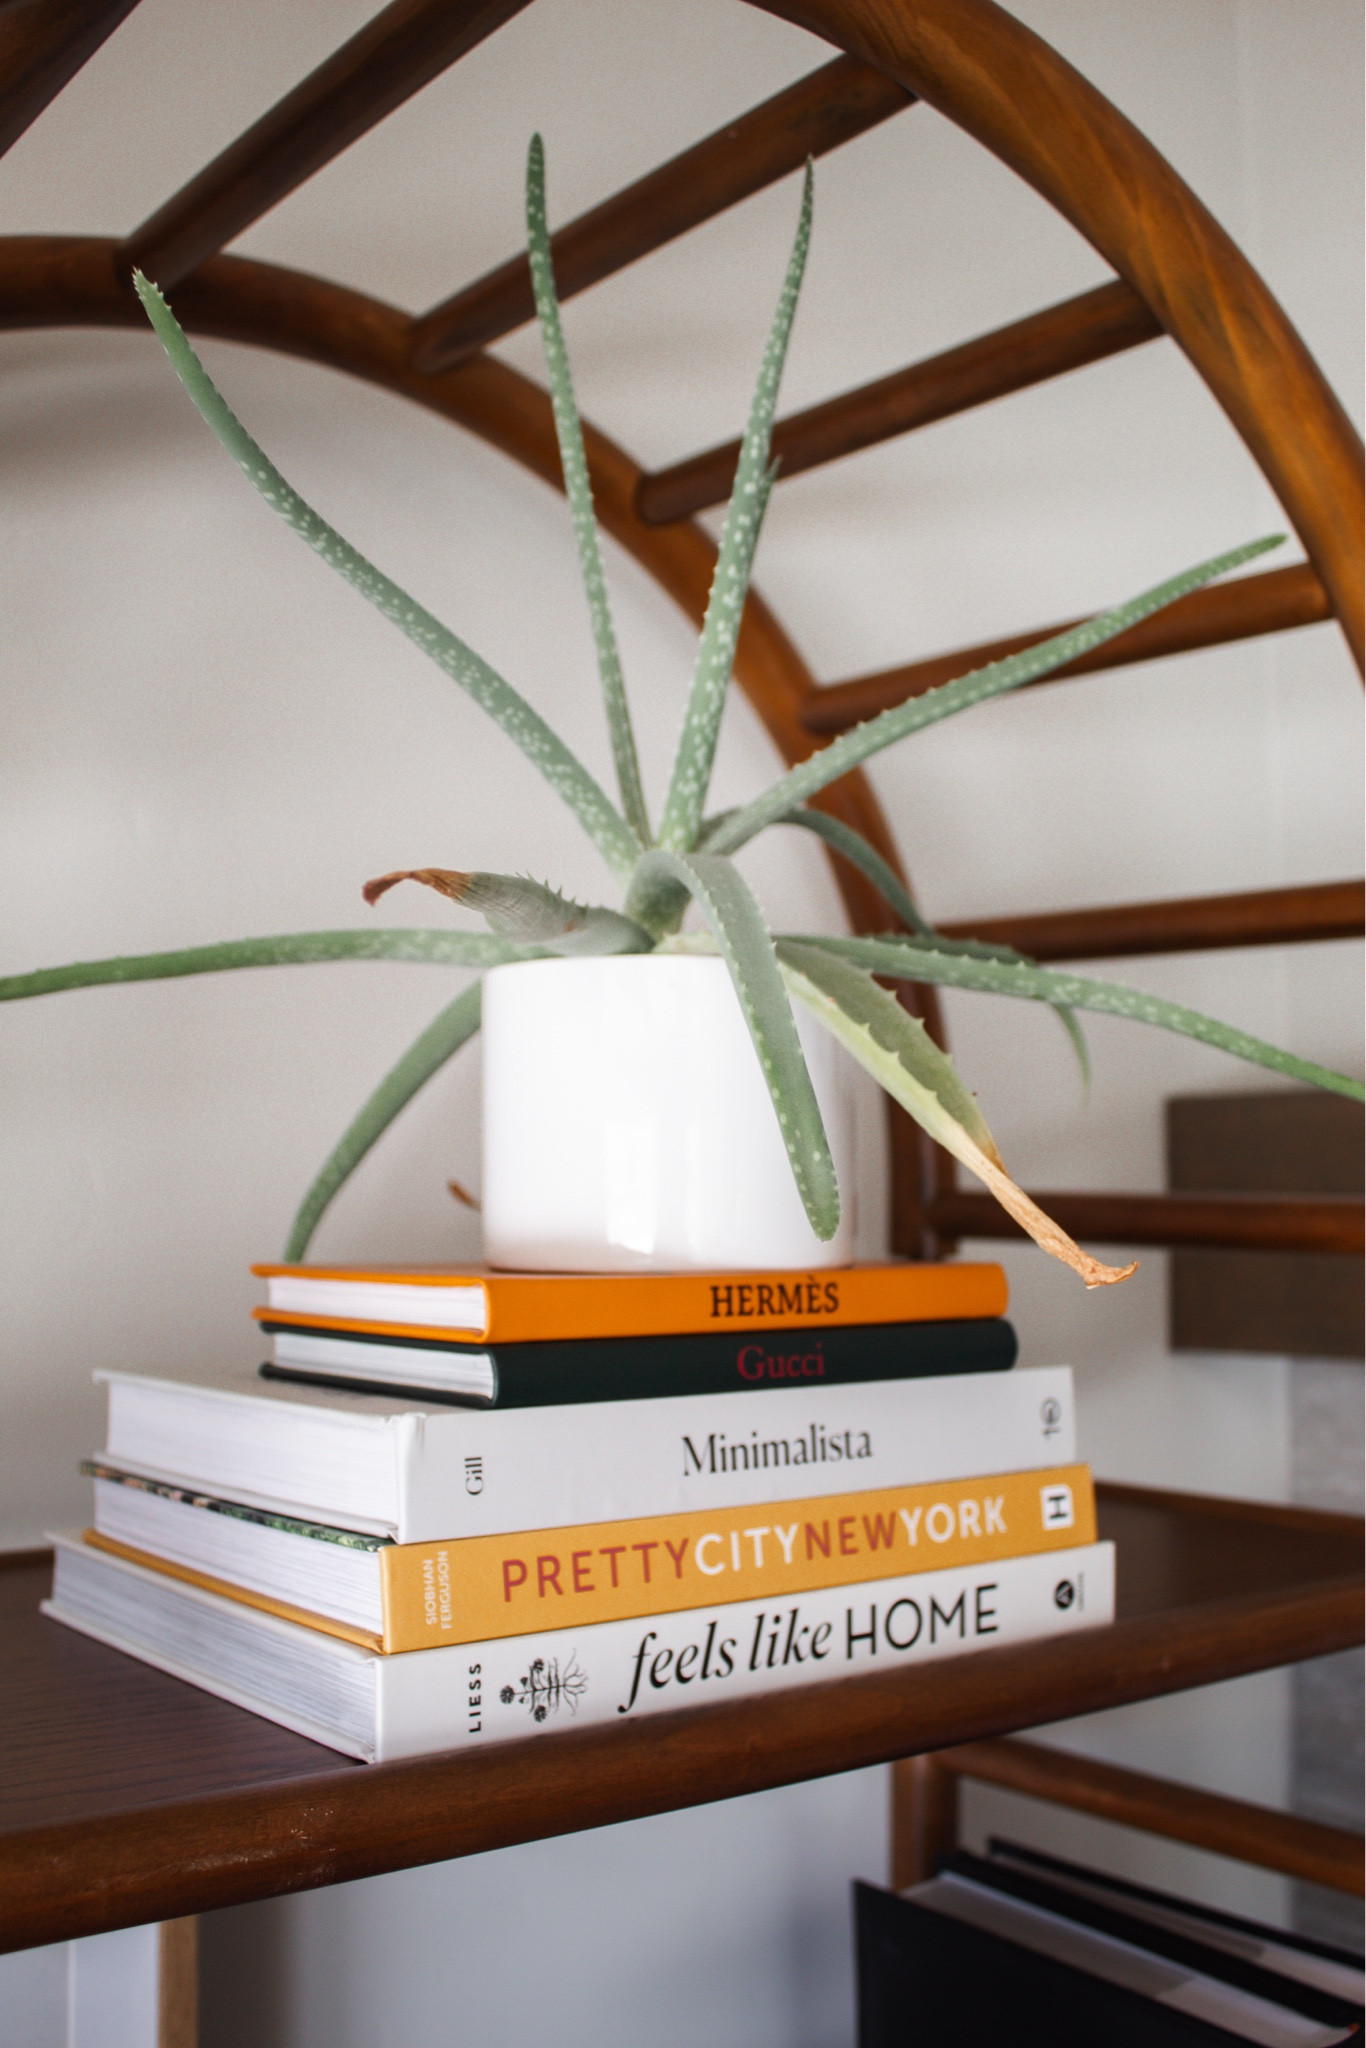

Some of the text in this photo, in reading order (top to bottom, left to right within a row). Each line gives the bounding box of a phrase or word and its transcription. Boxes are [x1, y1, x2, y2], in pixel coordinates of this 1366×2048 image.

[710, 1274, 839, 1317] HERMÈS
[736, 1341, 825, 1380] Gucci
[464, 1456, 484, 1496] Gill
[681, 1422, 873, 1476] Minimalista
[422, 1558, 438, 1626] SIOBHAN
[436, 1550, 453, 1630] FERGUSON
[617, 1619, 738, 1714] feels
[748, 1607, 832, 1672] like
[846, 1583, 998, 1659] HOME
[469, 1662, 482, 1733] LIESS
